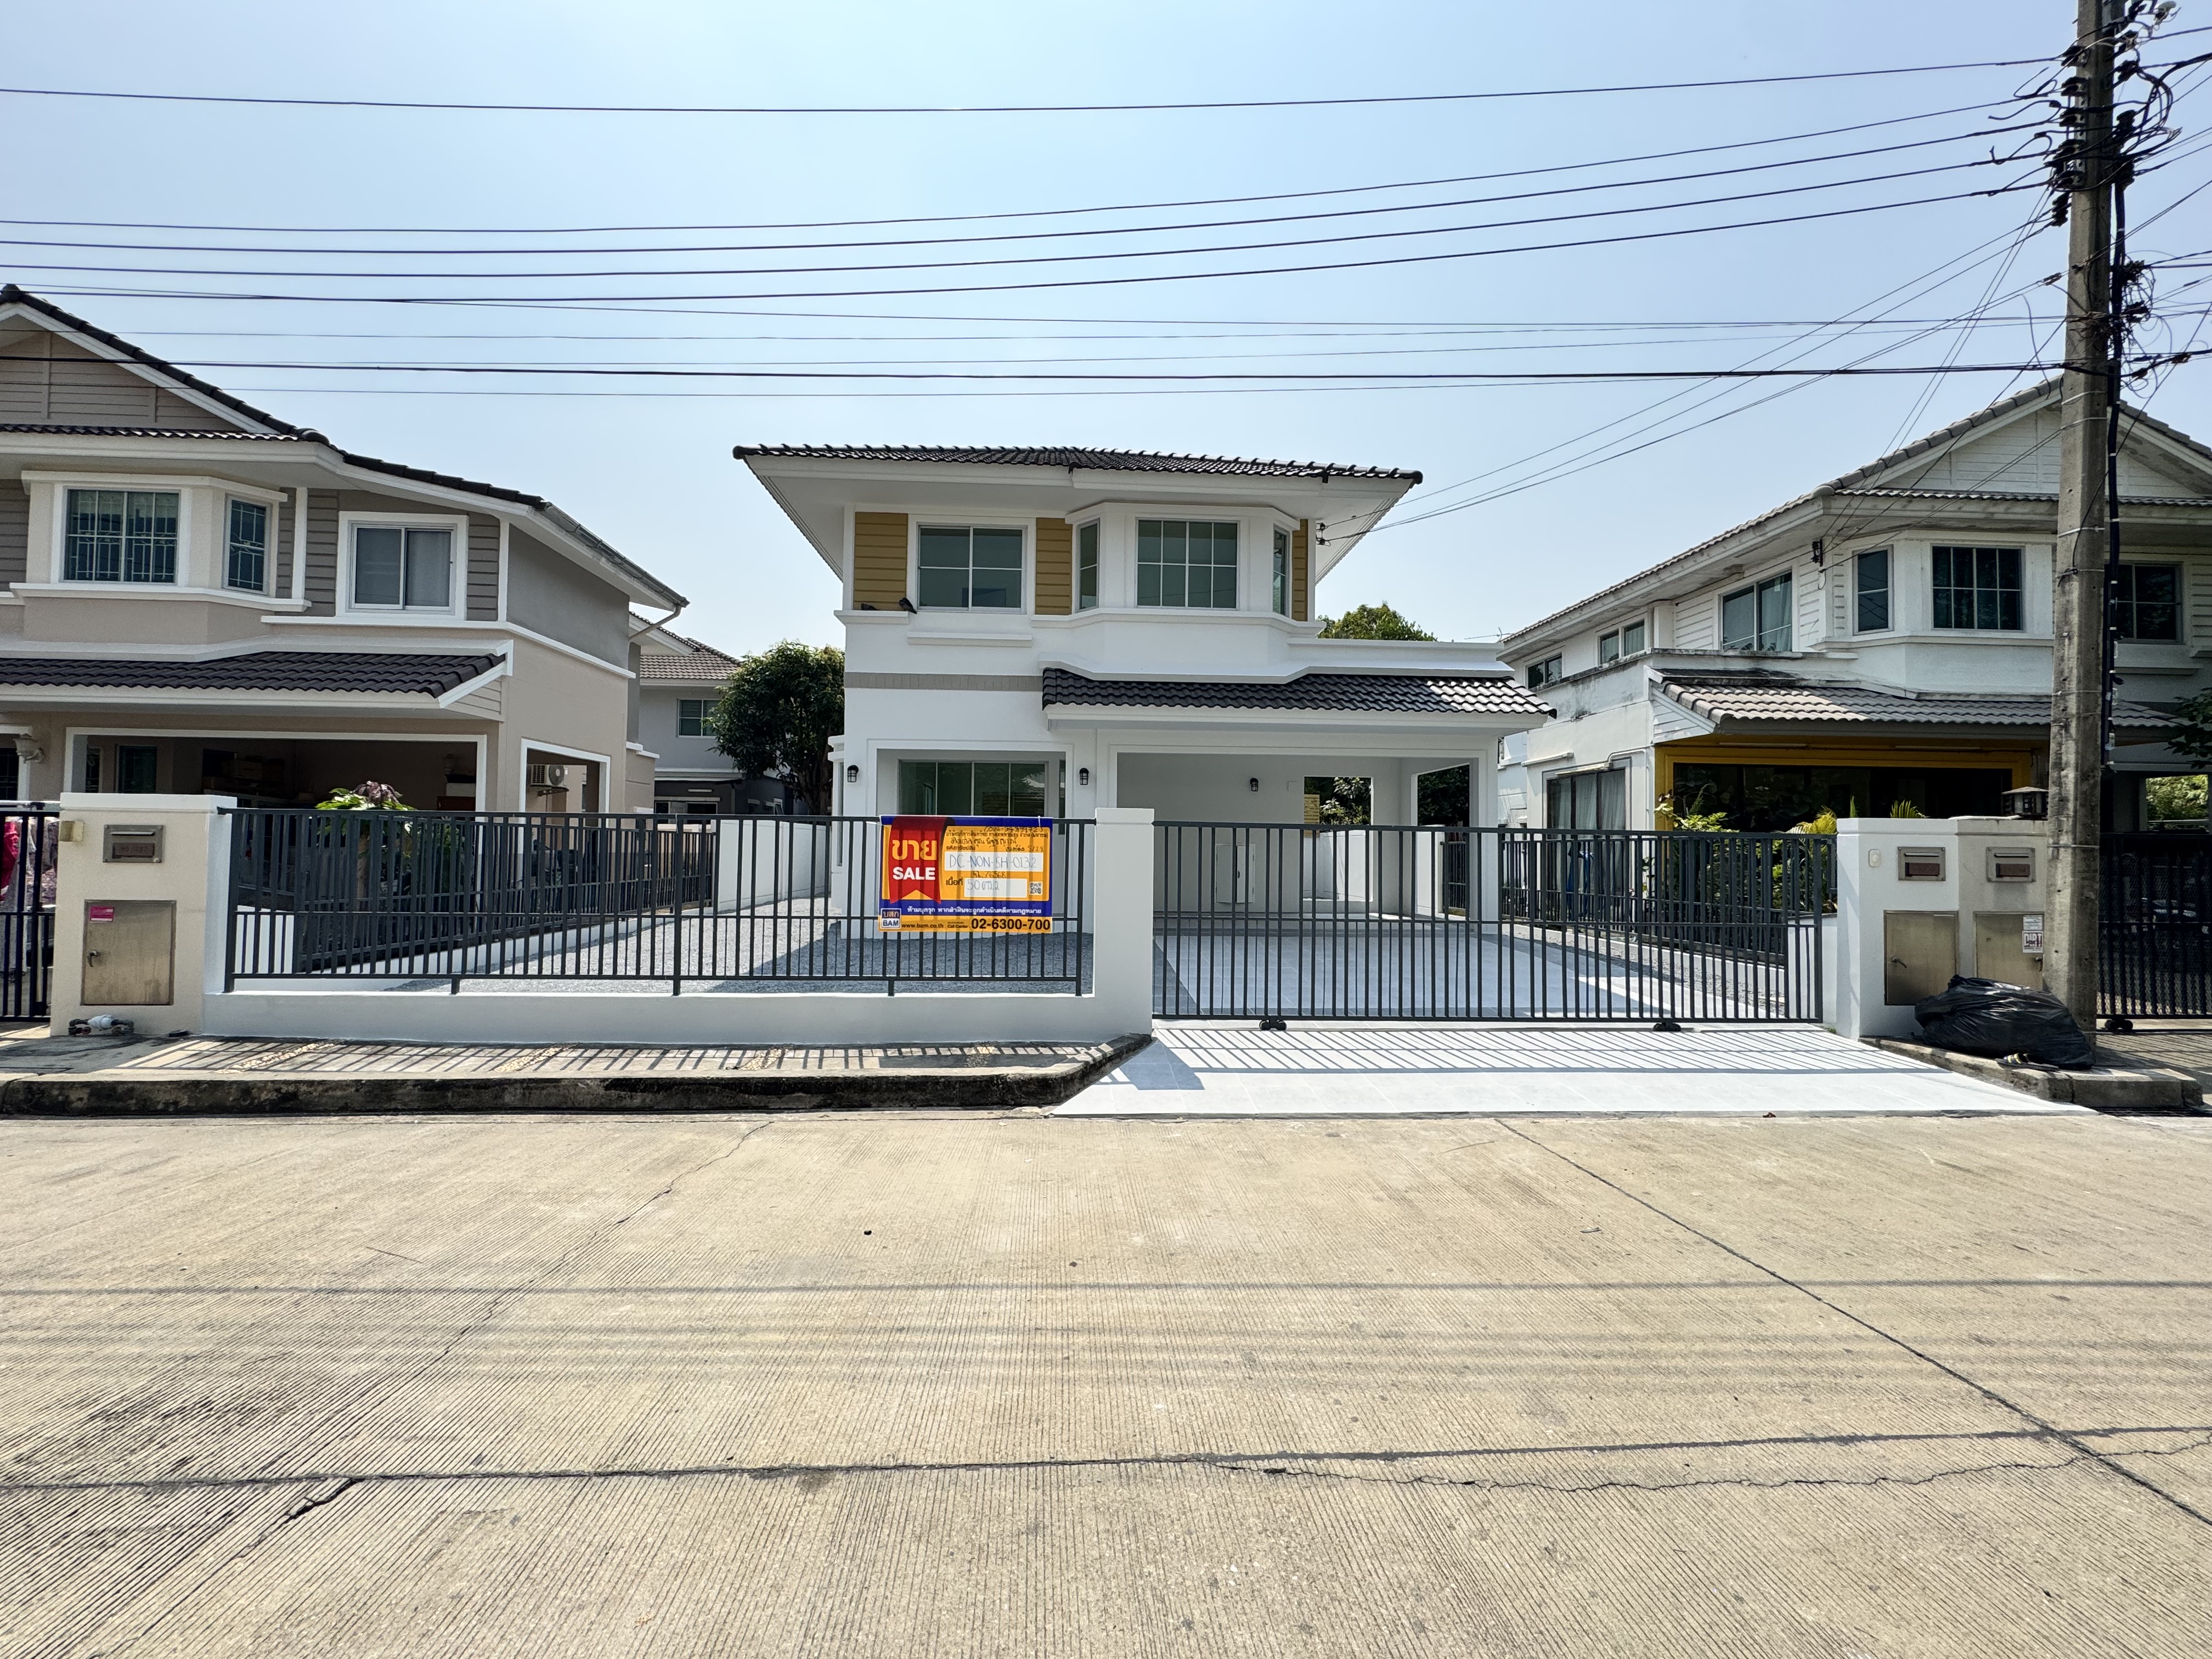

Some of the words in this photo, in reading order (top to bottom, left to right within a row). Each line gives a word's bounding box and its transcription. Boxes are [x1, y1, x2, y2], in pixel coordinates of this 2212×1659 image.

[892, 840, 937, 860] ขาย
[893, 867, 935, 880] SALE
[946, 876, 963, 885] เนื้อที่
[907, 906, 935, 915] ห้ามบุกรุก
[972, 918, 1051, 930] 02-6300-700
